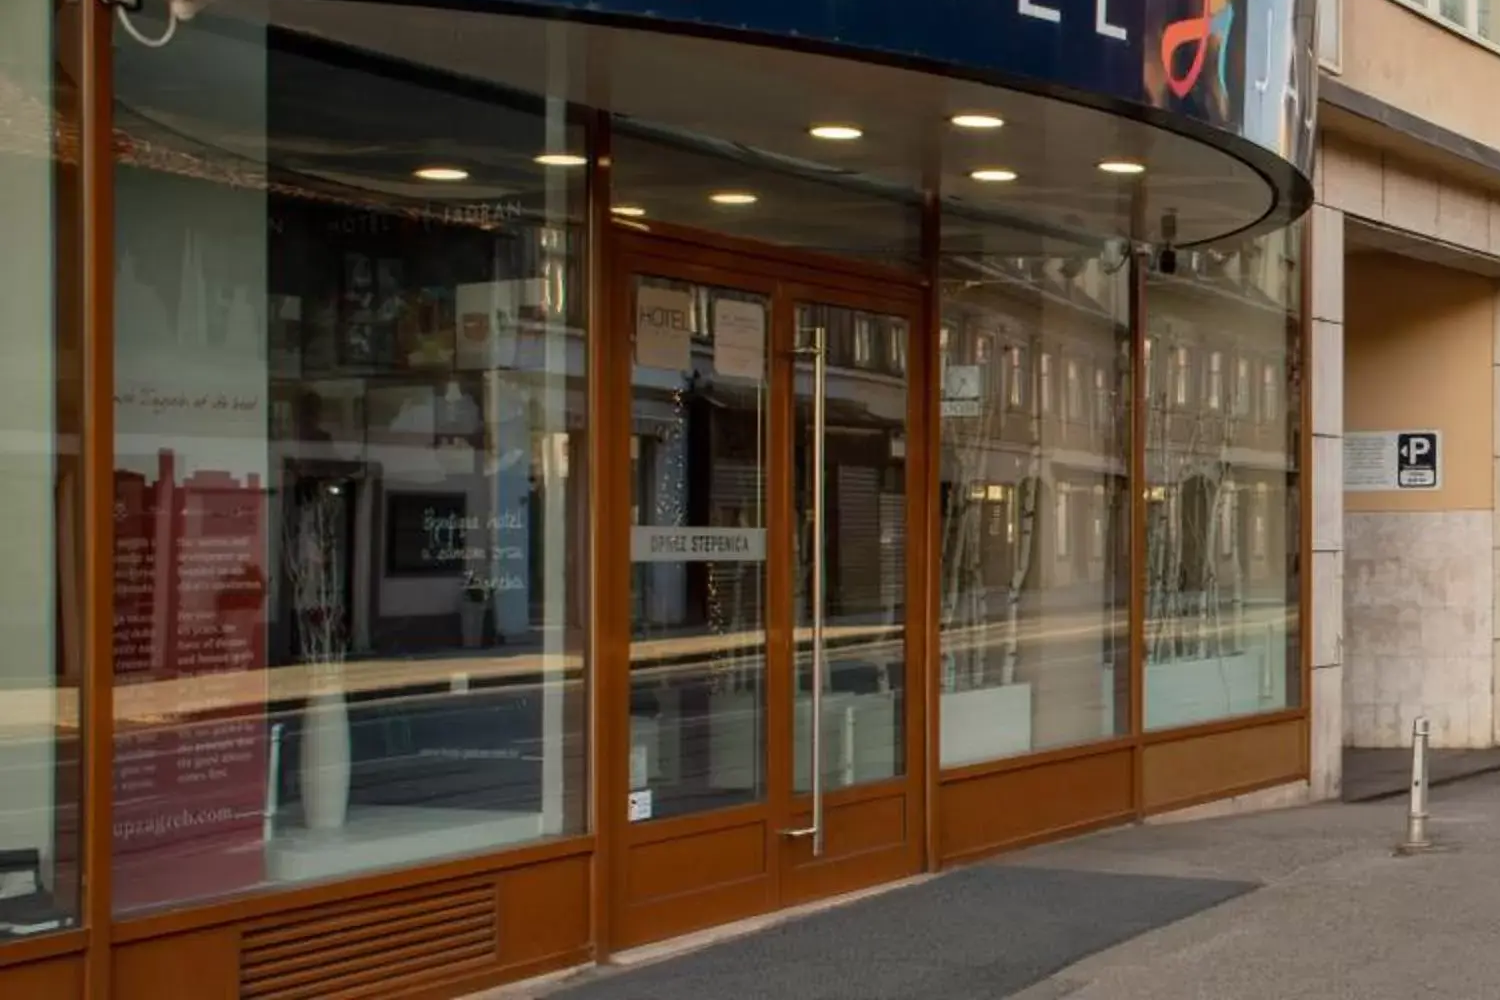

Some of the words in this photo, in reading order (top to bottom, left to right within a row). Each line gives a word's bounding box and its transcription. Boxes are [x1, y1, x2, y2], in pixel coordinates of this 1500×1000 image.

[640, 303, 690, 333] HOTEL
[1409, 437, 1431, 465] P
[691, 534, 750, 553] STEPENICA
